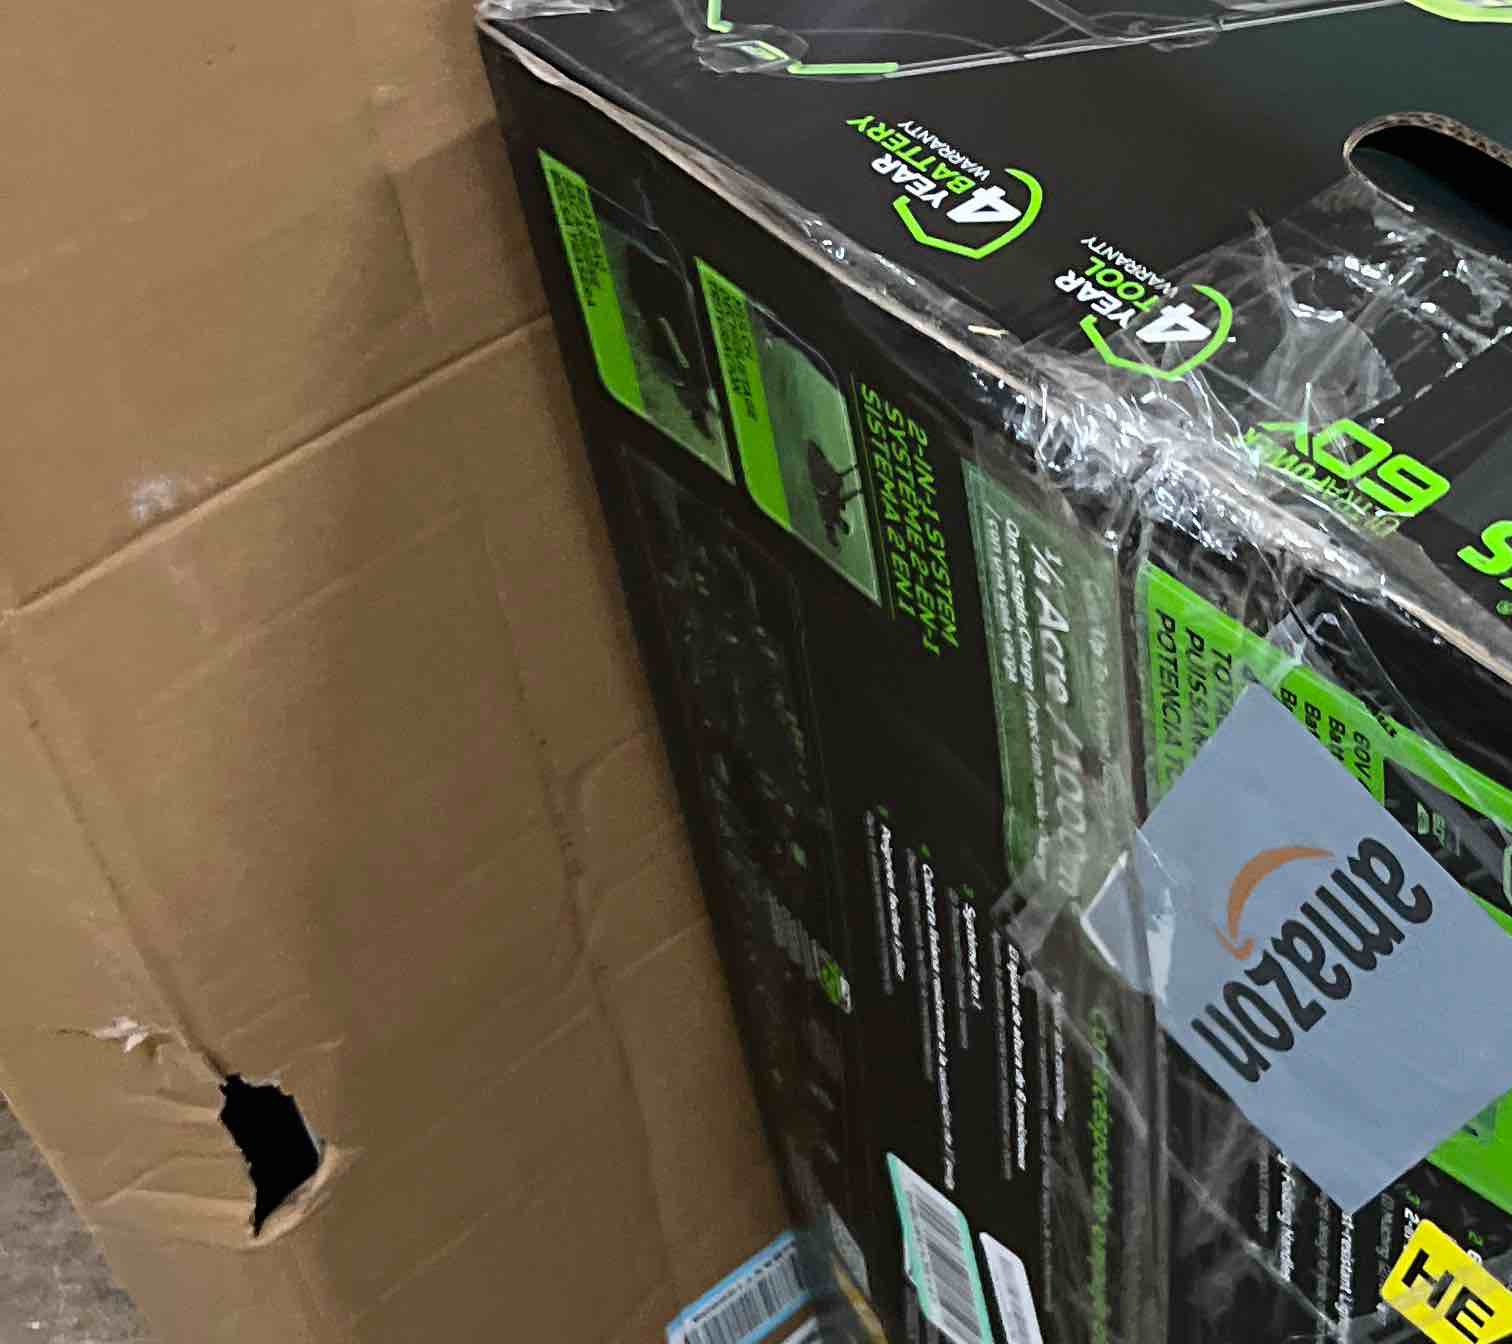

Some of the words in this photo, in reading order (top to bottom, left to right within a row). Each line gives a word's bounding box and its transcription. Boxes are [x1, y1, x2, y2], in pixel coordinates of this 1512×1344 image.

[847, 116, 974, 193] BATTERY
[865, 152, 954, 208] YEAR
[897, 120, 989, 180] WARRANTY
[941, 182, 1035, 230] 4
[1055, 270, 1134, 326] YEAR
[1077, 254, 1164, 311] TOOL
[1081, 237, 1178, 297] WARRANTY
[1136, 303, 1223, 346] 4
[859, 381, 901, 526] SISTEMA
[889, 549, 912, 597] EN
[883, 400, 926, 552] SYSTÈME
[908, 547, 940, 657] 2-EN-1
[906, 416, 940, 523] 2-IN-1
[923, 522, 958, 648] SYSTEM
[1003, 515, 1019, 550] On
[1008, 561, 1028, 626] Single
[1015, 623, 1036, 693] Charge
[1032, 586, 1074, 710] Acre
[1154, 606, 1181, 735] POTENCIA
[1184, 625, 1211, 769] PUISSAN
[1353, 729, 1370, 779] 60V
[919, 860, 939, 930] Cubierta
[959, 898, 981, 970] Système
[1191, 836, 1434, 1083] amazon
[924, 965, 954, 1051] resistente
[1004, 957, 1022, 1008] ajuste
[1010, 1022, 1026, 1071] altura
[1006, 1090, 1036, 1181] posiciones
[1275, 1151, 1294, 1228] y-Folding
[1277, 1222, 1294, 1285] Handles
[1338, 1209, 1353, 1295] st-resistant
